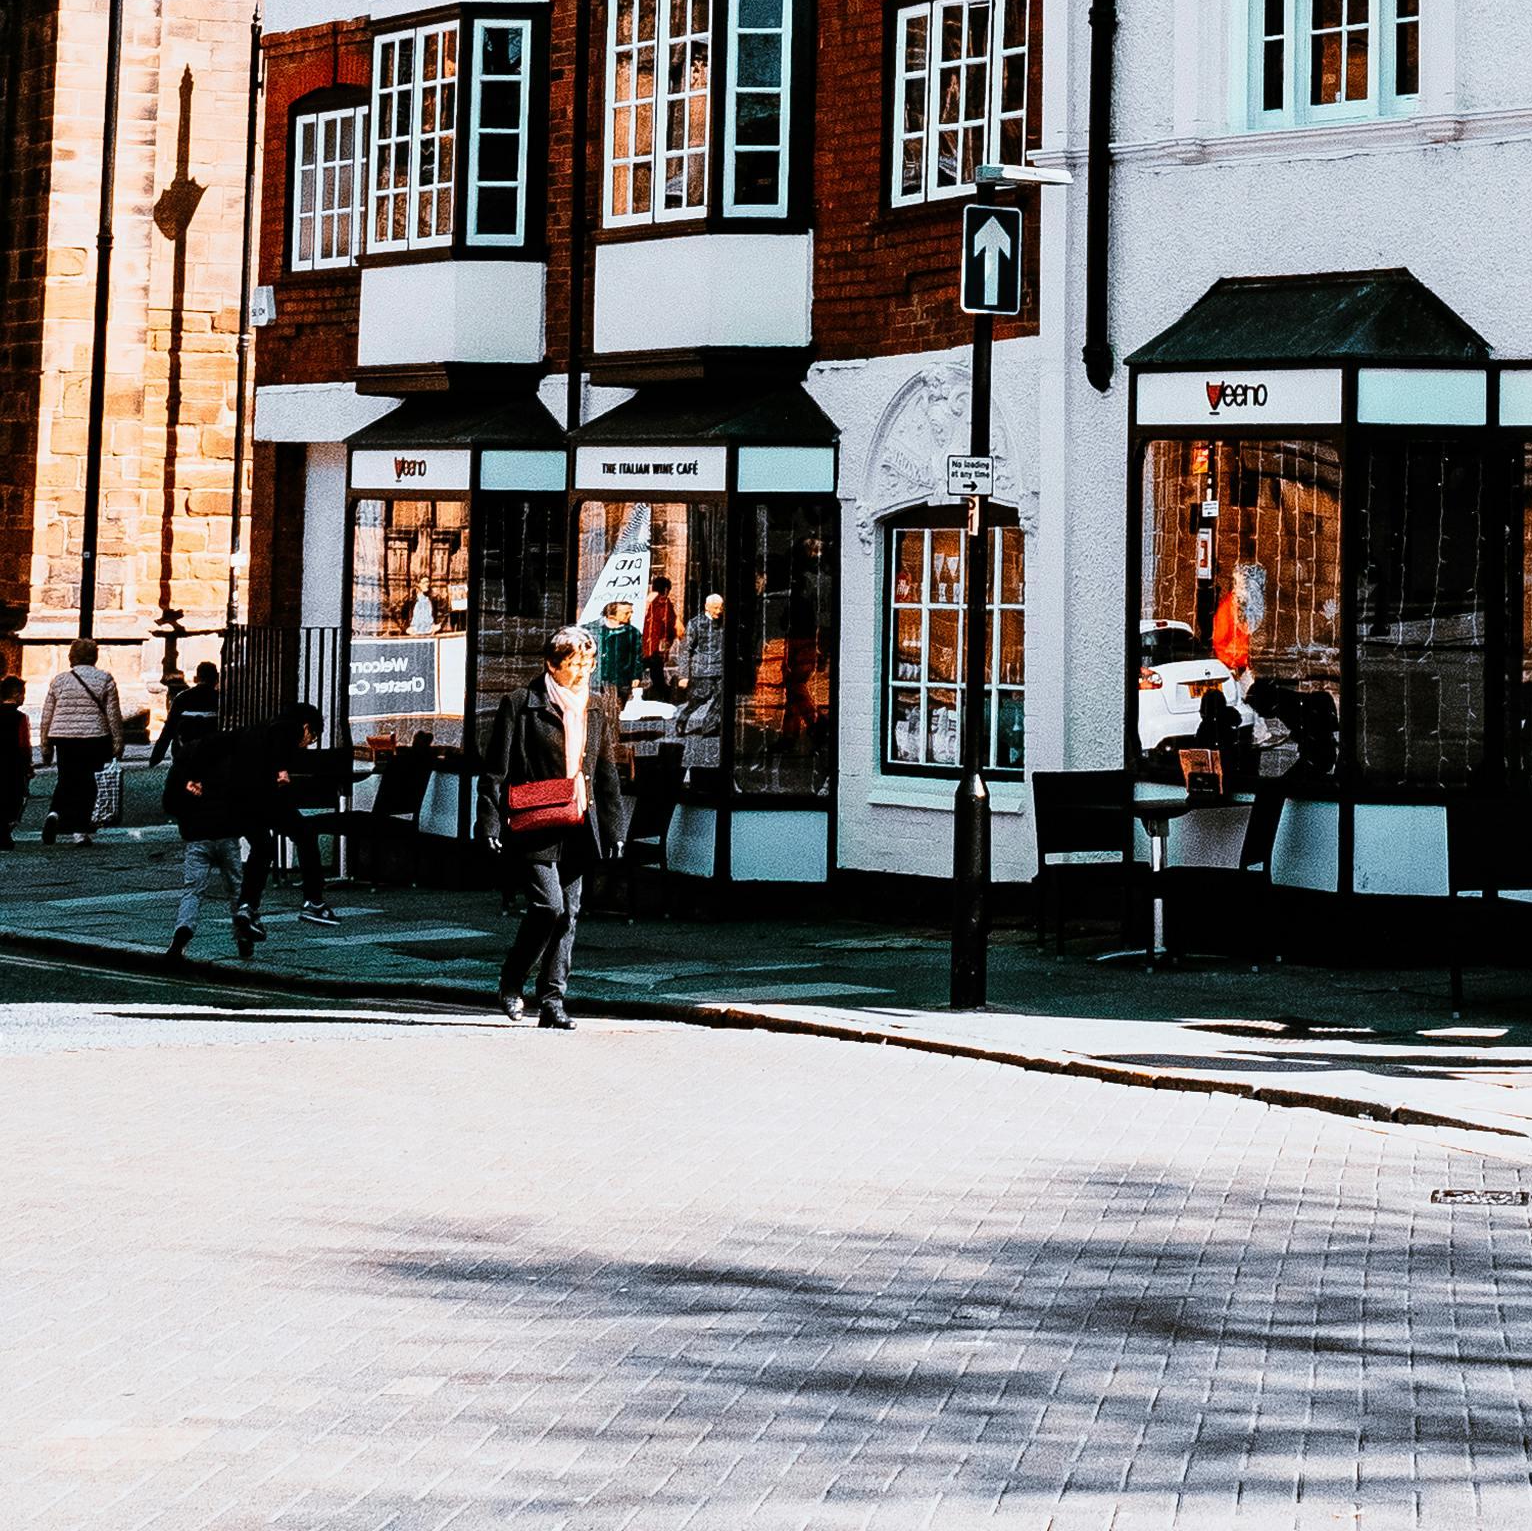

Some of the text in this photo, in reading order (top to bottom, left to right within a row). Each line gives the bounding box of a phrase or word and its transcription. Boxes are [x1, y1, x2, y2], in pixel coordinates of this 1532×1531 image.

[602, 460, 699, 475] THE ITALIAN WINE CAFÉ
[952, 460, 989, 470] No loading
[951, 470, 990, 479] at any time
